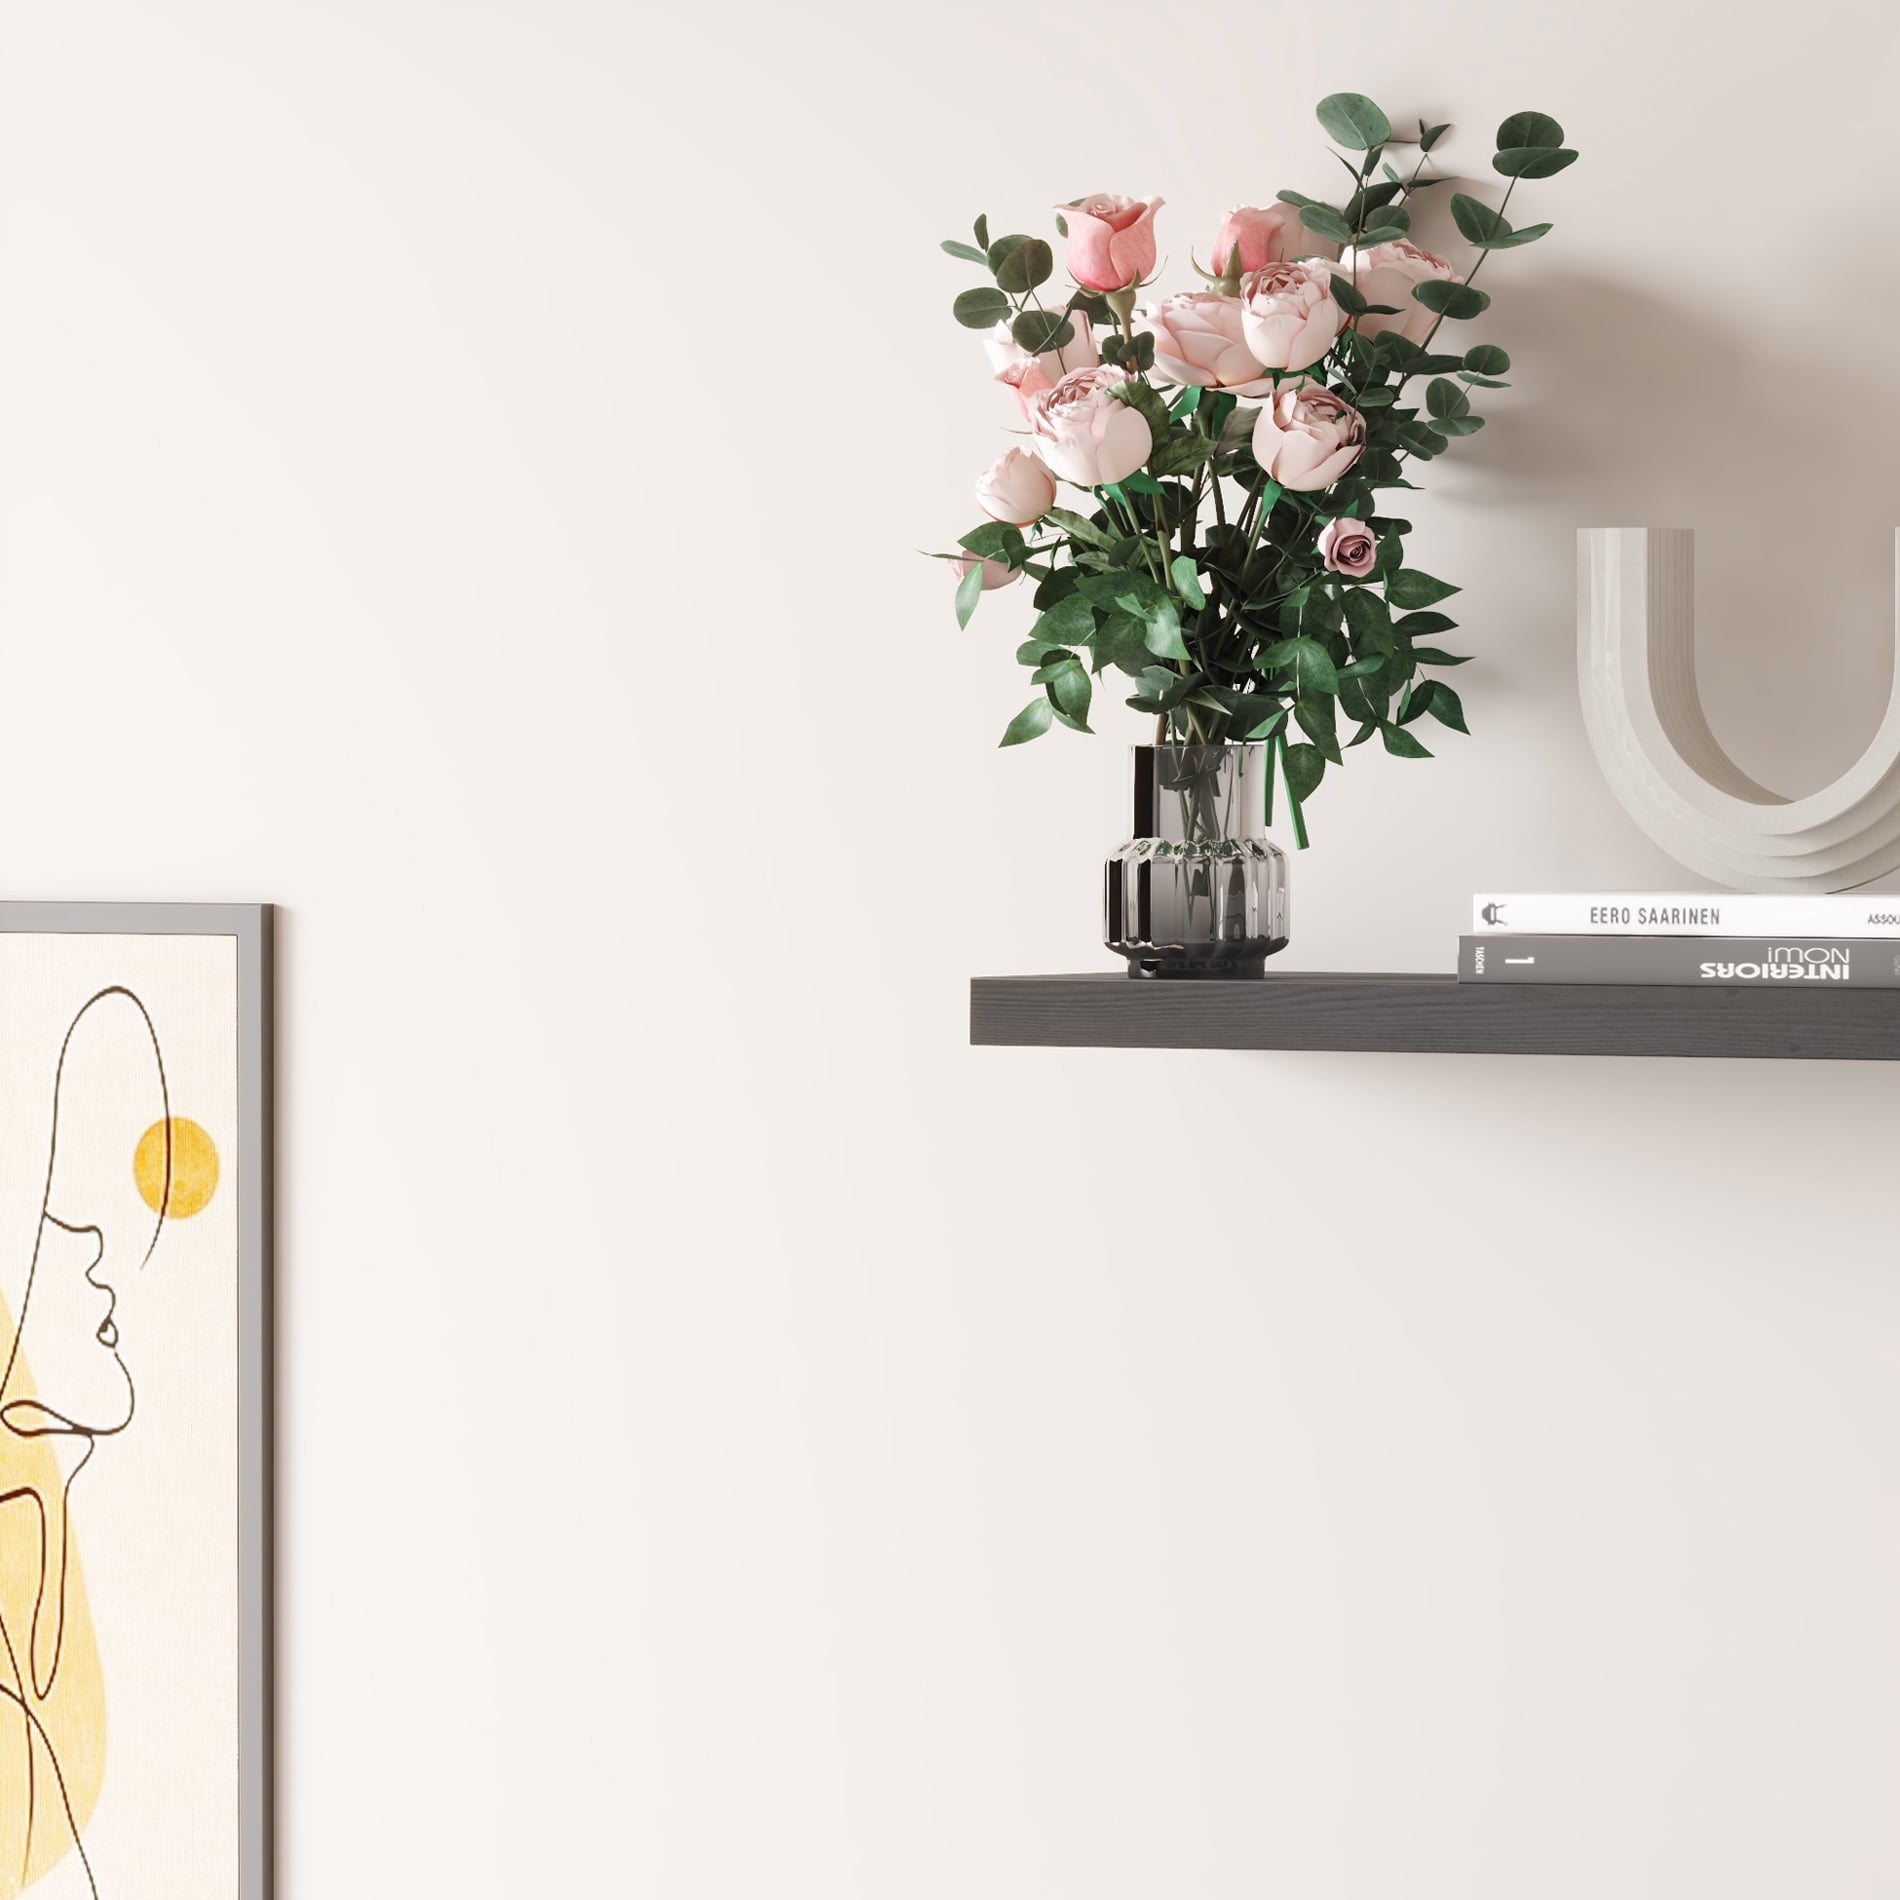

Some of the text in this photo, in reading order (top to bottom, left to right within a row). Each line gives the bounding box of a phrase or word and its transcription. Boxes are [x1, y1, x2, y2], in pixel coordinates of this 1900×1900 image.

[1590, 907, 1720, 925] EERO SAARINEN
[1768, 947, 1849, 963] NOW!
[1700, 962, 1849, 980] INTERIORS
